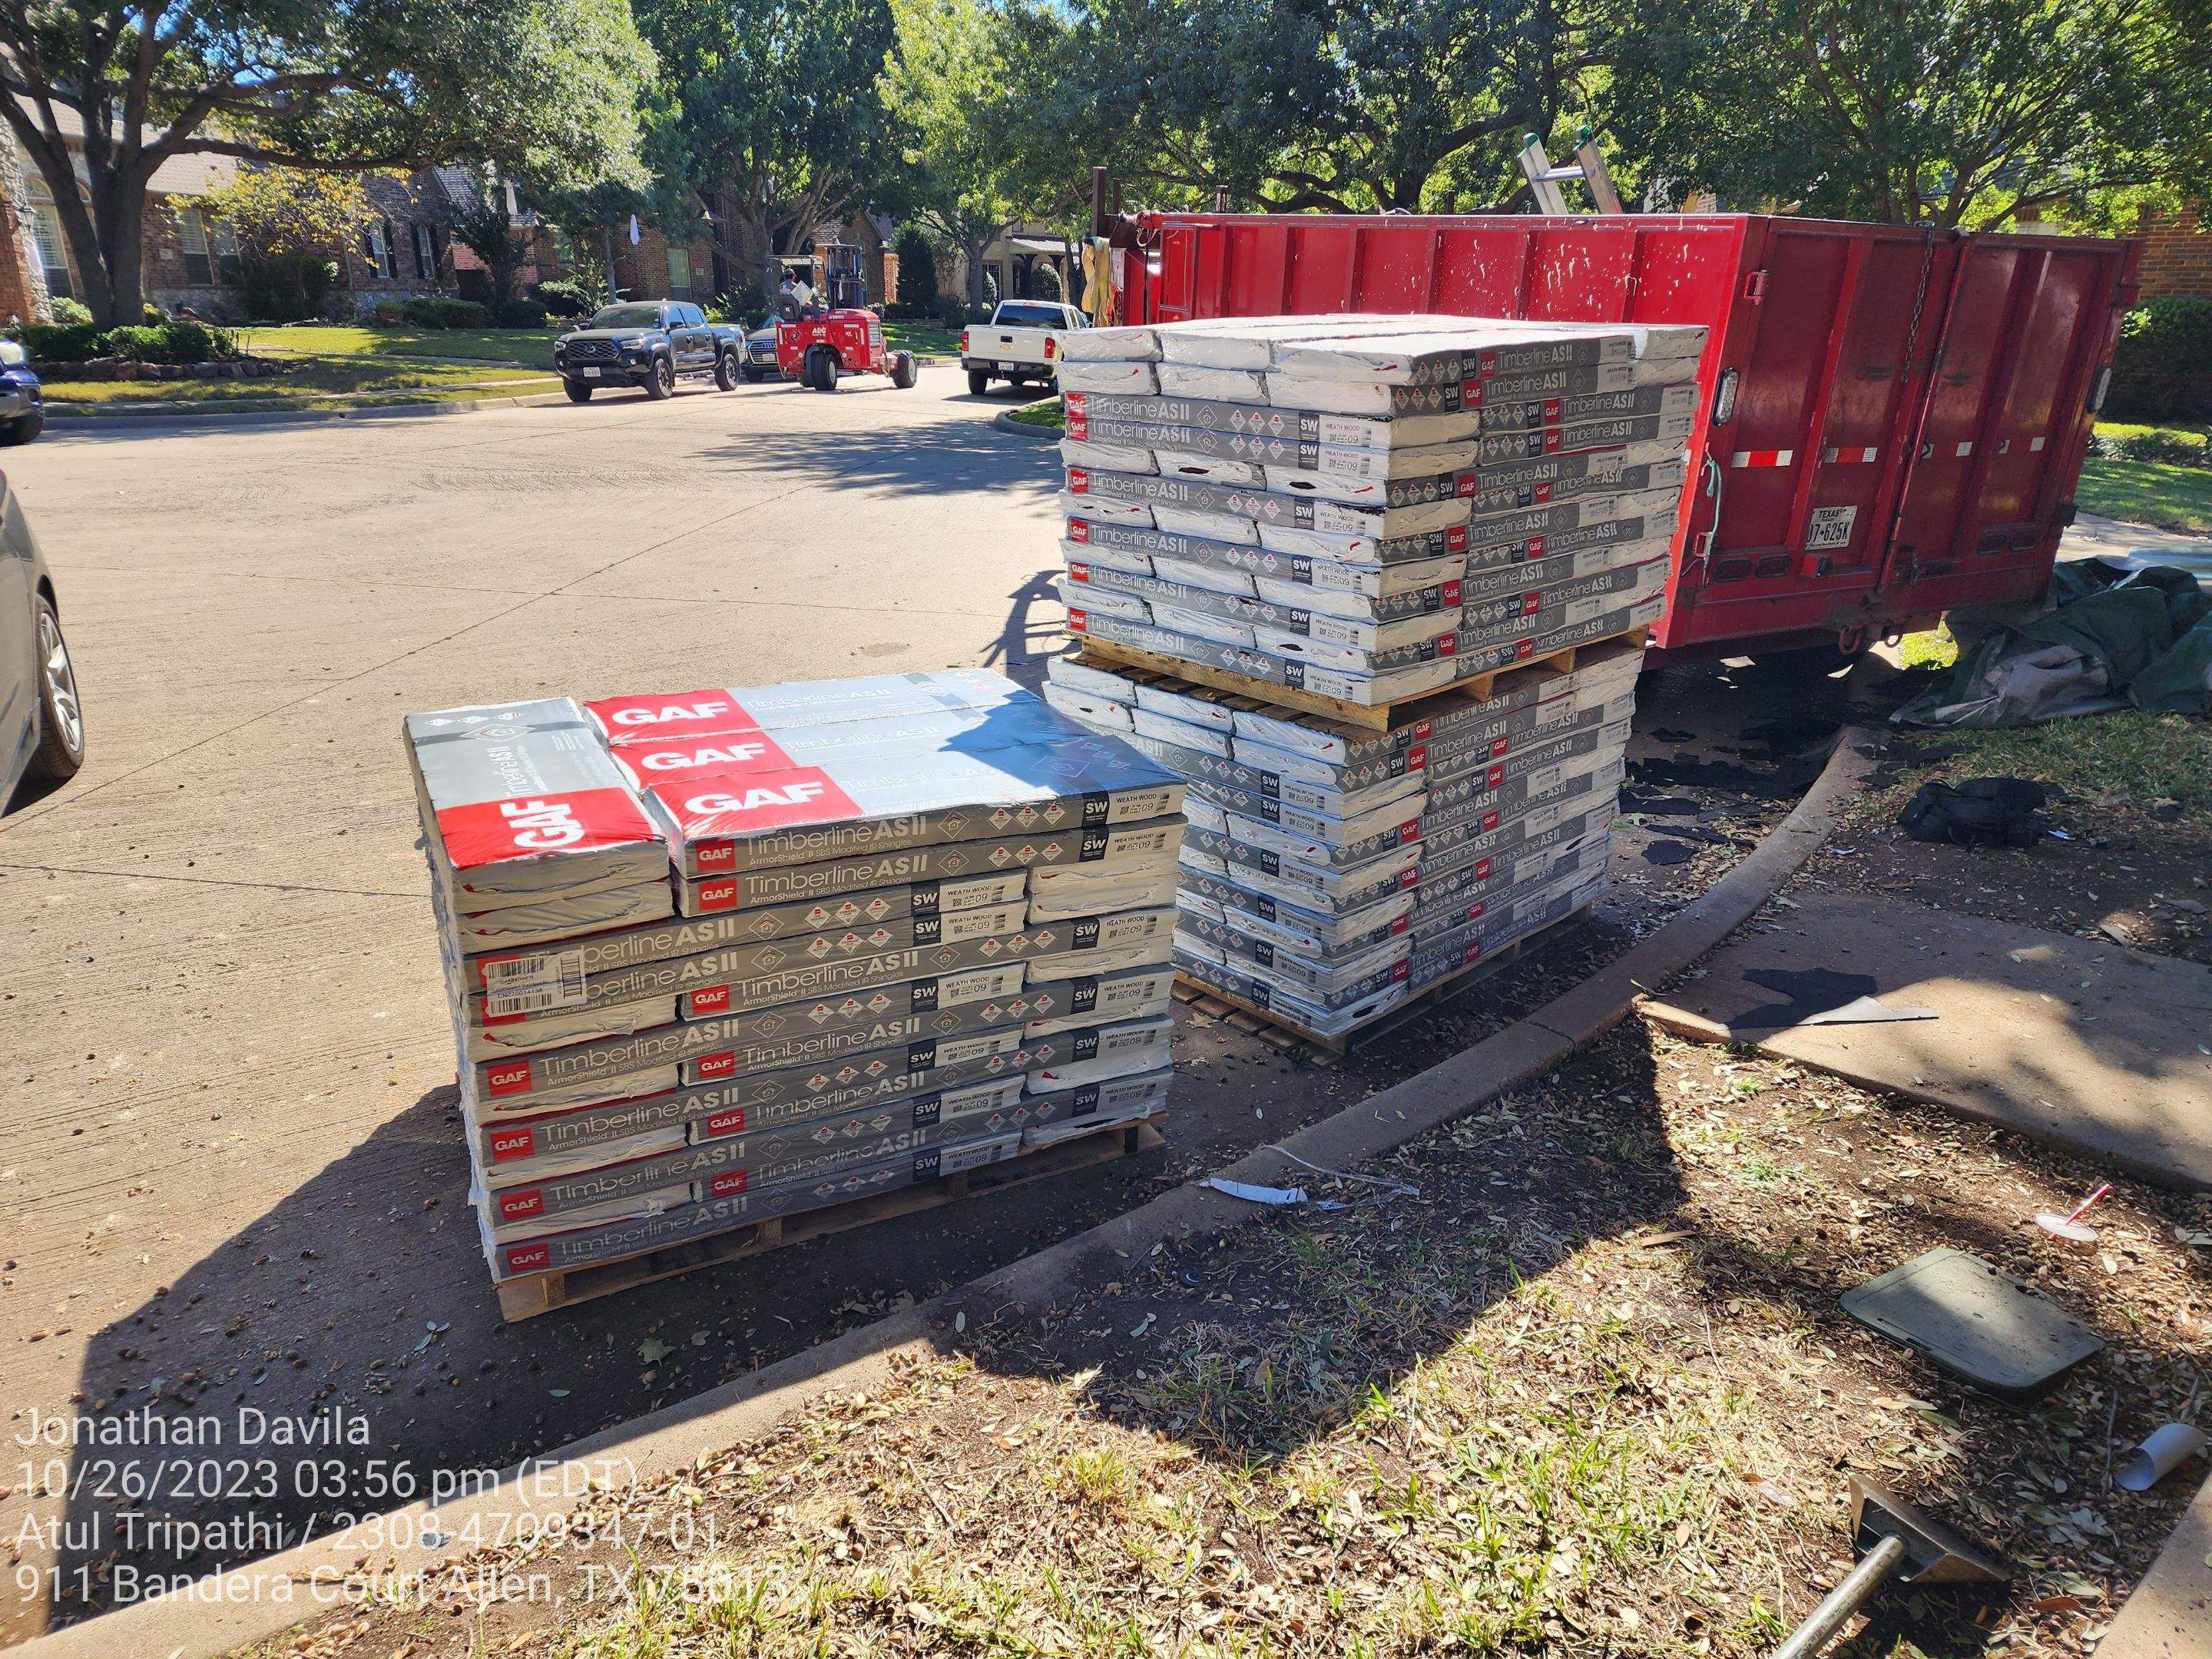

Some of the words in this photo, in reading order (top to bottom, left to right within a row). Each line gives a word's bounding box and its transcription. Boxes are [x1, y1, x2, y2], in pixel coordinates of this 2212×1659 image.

[1463, 359, 1475, 371] SW
[1482, 360, 1495, 370] GAF
[1445, 386, 1458, 399] SW
[1466, 388, 1481, 399] GAF
[1071, 422, 1085, 431] GAF
[1300, 445, 1317, 455] SW
[1073, 476, 1087, 485] GAF
[1820, 509, 1839, 518] TEXAS
[1073, 526, 1087, 536] GAF
[1071, 615, 1084, 624] GAF
[1292, 611, 1308, 621] SW
[611, 701, 730, 726] GAF
[641, 743, 766, 770] GAF
[1411, 754, 1424, 764] GAF
[1391, 757, 1403, 769] SW
[1472, 775, 1484, 786] SW
[1489, 770, 1502, 780] GAF
[684, 781, 824, 815] GAF
[1085, 801, 1108, 814] SW
[1141, 803, 1154, 812] 09
[1262, 801, 1277, 813] SW
[499, 800, 585, 847] GAF
[1083, 839, 1106, 850] SW
[699, 847, 732, 861] GAF
[701, 888, 733, 901] GAF
[912, 892, 938, 906] SW
[975, 892, 988, 902] 09
[915, 921, 939, 934] SW
[977, 922, 990, 930] 09
[1106, 919, 1127, 927] WEATH
[1128, 916, 1145, 924] WOOD
[1075, 923, 1098, 936] SW
[1130, 925, 1142, 933] 09
[945, 979, 969, 989] WEATH
[694, 992, 727, 1004] GAF
[912, 986, 936, 998] SW
[1075, 988, 1094, 1001] SW
[1076, 1038, 1097, 1050] SW
[910, 1051, 934, 1064] SW
[700, 1059, 731, 1071] GAF
[492, 1071, 527, 1085] GAF
[916, 1103, 939, 1116] SW
[710, 1115, 740, 1128] GAF
[495, 1137, 528, 1151] GAF
[714, 1178, 743, 1190] GAF
[504, 1198, 538, 1212] GAF
[511, 1252, 546, 1265] GAF
